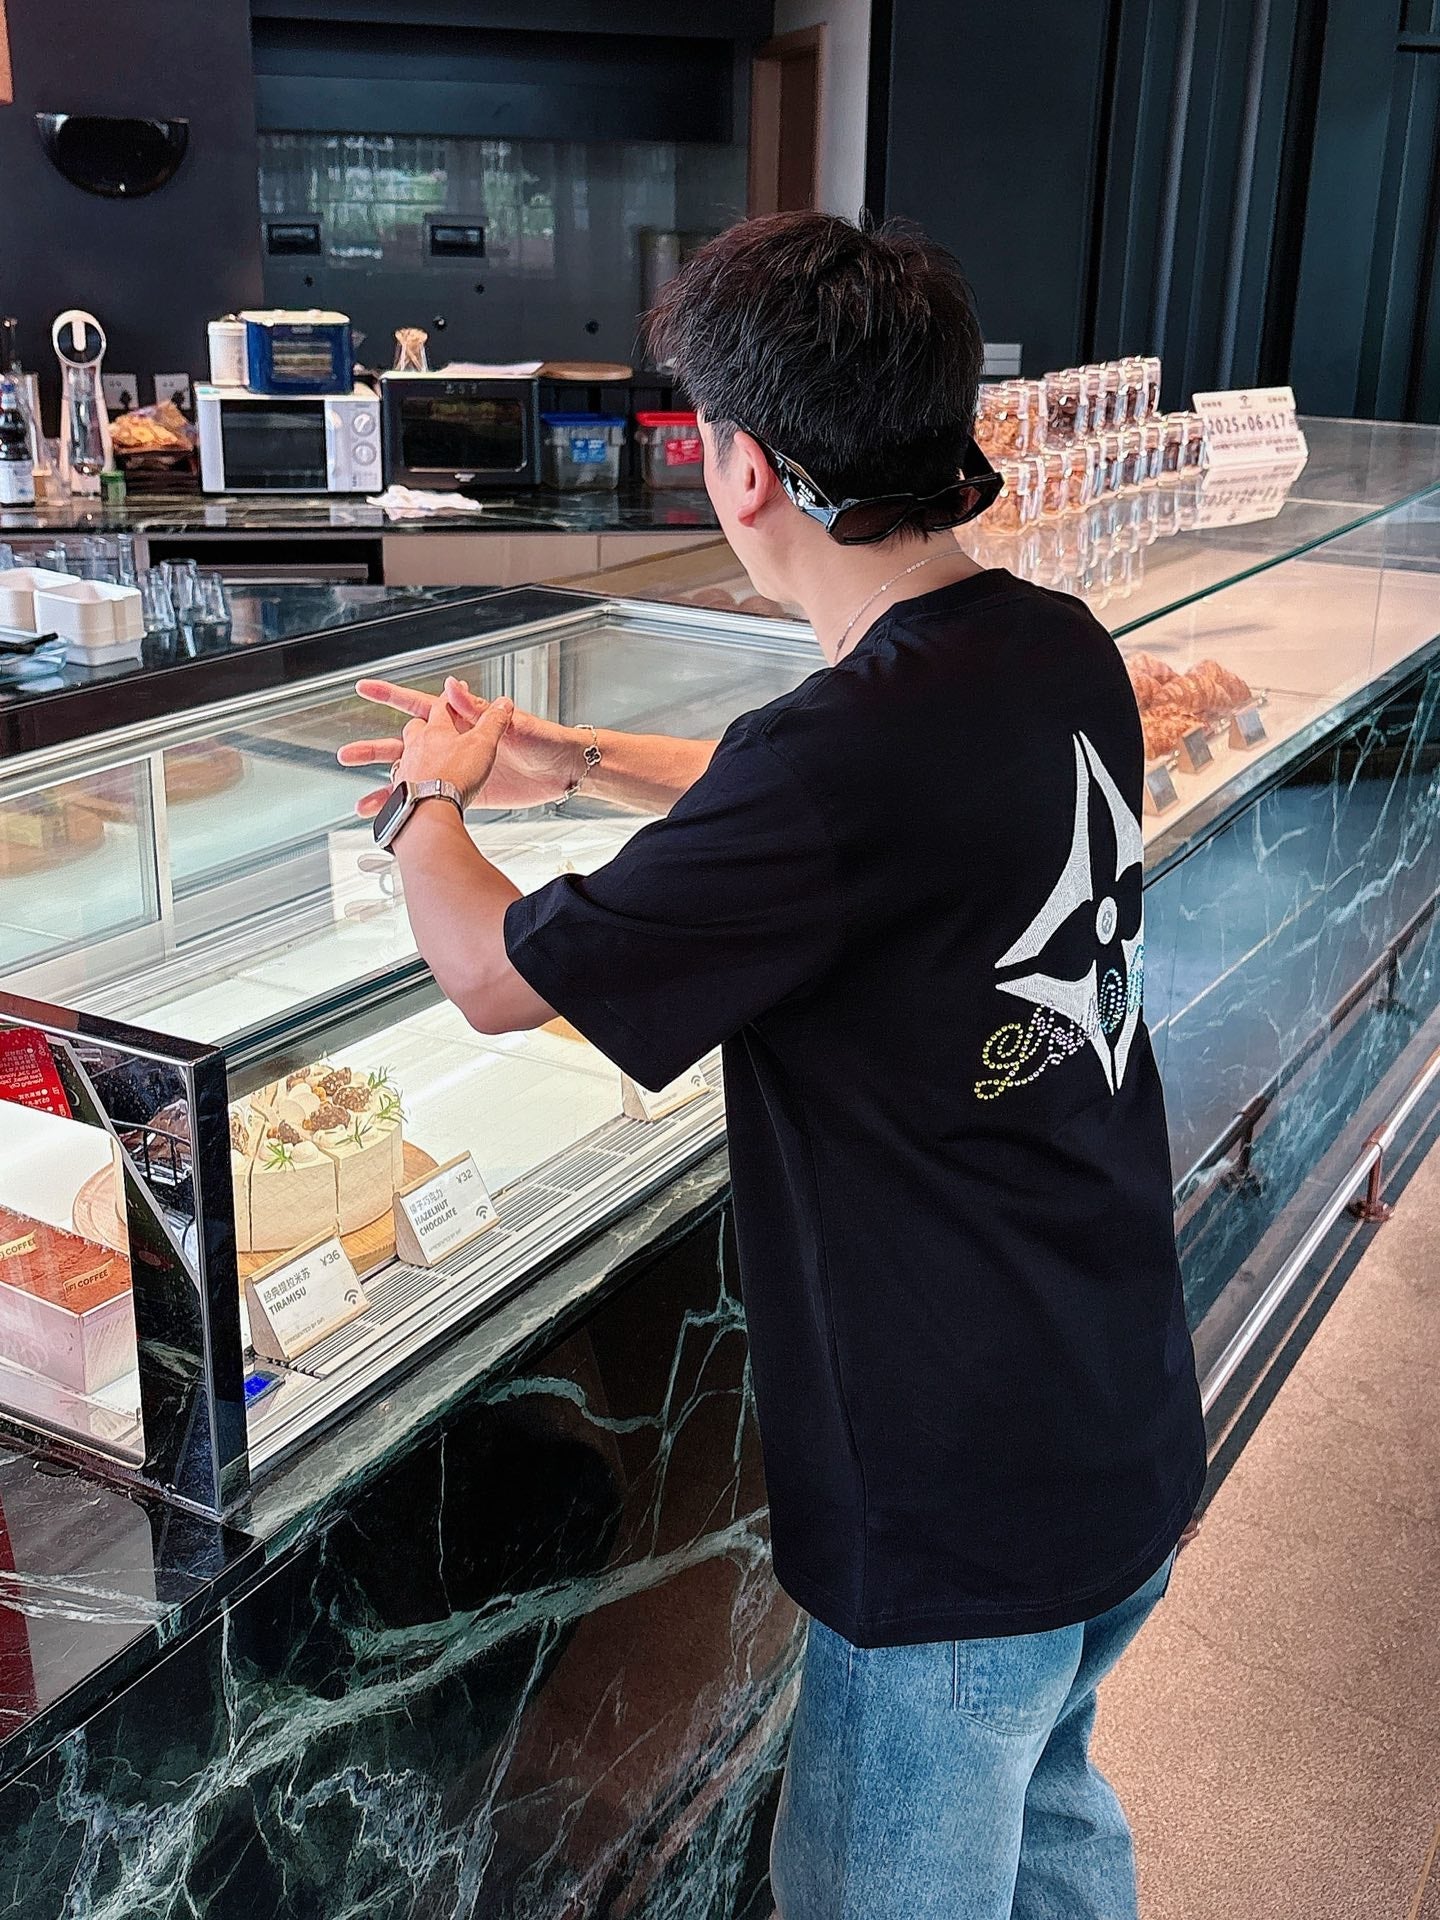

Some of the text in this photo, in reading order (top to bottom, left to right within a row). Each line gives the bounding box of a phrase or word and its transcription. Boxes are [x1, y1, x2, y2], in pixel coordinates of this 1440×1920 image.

[414, 1199, 449, 1226] HAZELNUT
[419, 1207, 458, 1236] CHOCOLATE
[320, 1249, 341, 1267] ¥36
[77, 1269, 109, 1288] COFFEE
[263, 1267, 311, 1304] 经典提拉米苏
[268, 1286, 307, 1316] TIRAMISU
